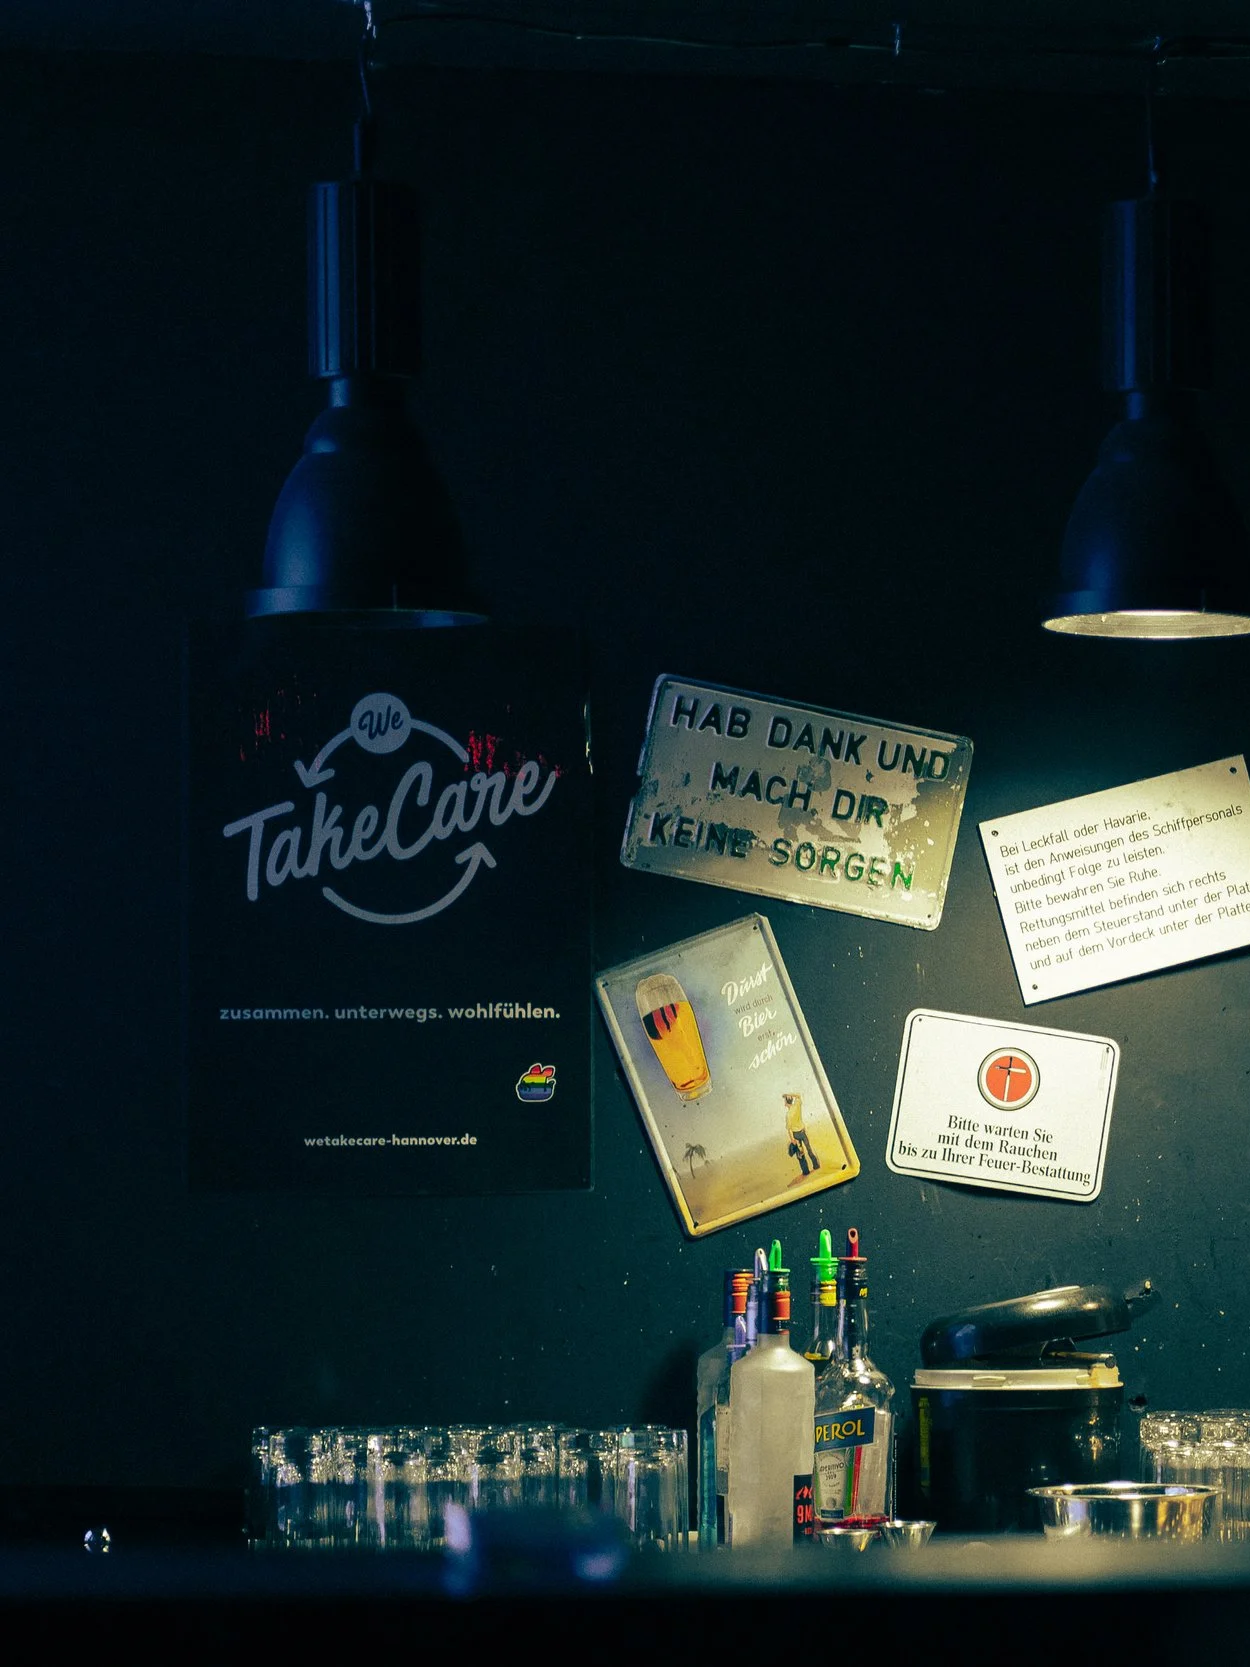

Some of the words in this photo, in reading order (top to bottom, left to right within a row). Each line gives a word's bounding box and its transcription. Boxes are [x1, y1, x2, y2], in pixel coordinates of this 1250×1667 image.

[358, 704, 404, 741] We
[671, 695, 751, 739] HAB
[766, 715, 867, 766] DANK
[877, 739, 951, 781] UND
[709, 762, 815, 812] MACH
[831, 788, 889, 828] DIR
[649, 811, 754, 859] KEINE
[769, 836, 916, 891] SORGEN
[1000, 842, 1020, 858] Bei
[1022, 829, 1069, 853] Leckfall
[1073, 822, 1099, 839] oder
[1004, 863, 1020, 876] ist
[1024, 858, 1045, 872] den
[1049, 836, 1125, 864] Anweisungen
[1128, 829, 1150, 844] des
[1152, 803, 1244, 837] Schiffpersonals
[1010, 870, 1066, 894] unbedingt
[1068, 861, 1102, 879] Folge
[1107, 857, 1120, 869] zu
[1123, 846, 1165, 864] leisten.
[1015, 899, 1042, 915] Bitte
[1046, 883, 1104, 906] bewahren
[1107, 874, 1125, 889] Sie
[1129, 866, 1161, 884] Ruhe.
[1019, 899, 1105, 934] Rettungsmittel
[1108, 889, 1159, 909] befinden
[1162, 881, 1185, 896] sich
[1188, 870, 1227, 889] rechts
[1025, 935, 1061, 952] neben
[1065, 926, 1091, 942] dem
[1093, 907, 1165, 934] Steuerstand
[1168, 898, 1198, 914] unter
[1203, 891, 1222, 905] der
[1029, 956, 1051, 971] und
[1055, 950, 1075, 965] auf
[1078, 943, 1104, 958] dem
[1107, 928, 1156, 950] Vordeck
[1159, 920, 1190, 936] unter
[1195, 912, 1213, 927] der
[219, 1006, 330, 1021] zusammen.
[334, 1005, 444, 1023] unterwegs.
[448, 1002, 561, 1020] wohlfühlen.
[733, 1001, 751, 1015] wird
[752, 994, 773, 1008] durch
[738, 1007, 777, 1038] Bier
[748, 1031, 798, 1070] schön
[304, 1133, 478, 1147] wetakecare-hannover.de
[937, 1132, 960, 1146] mit
[964, 1134, 994, 1151] dem
[998, 1139, 1058, 1161] Rauchen
[948, 1114, 980, 1132] Bitte
[984, 1123, 1029, 1140] warten
[1032, 1128, 1053, 1144] Sie
[898, 1140, 918, 1157] bis
[921, 1146, 937, 1160] zu
[941, 1147, 976, 1165] Ihrer
[978, 1153, 1091, 1187] Feuer-Bestattung
[815, 1419, 866, 1443] PEROL
[796, 1504, 813, 1524] 9M
